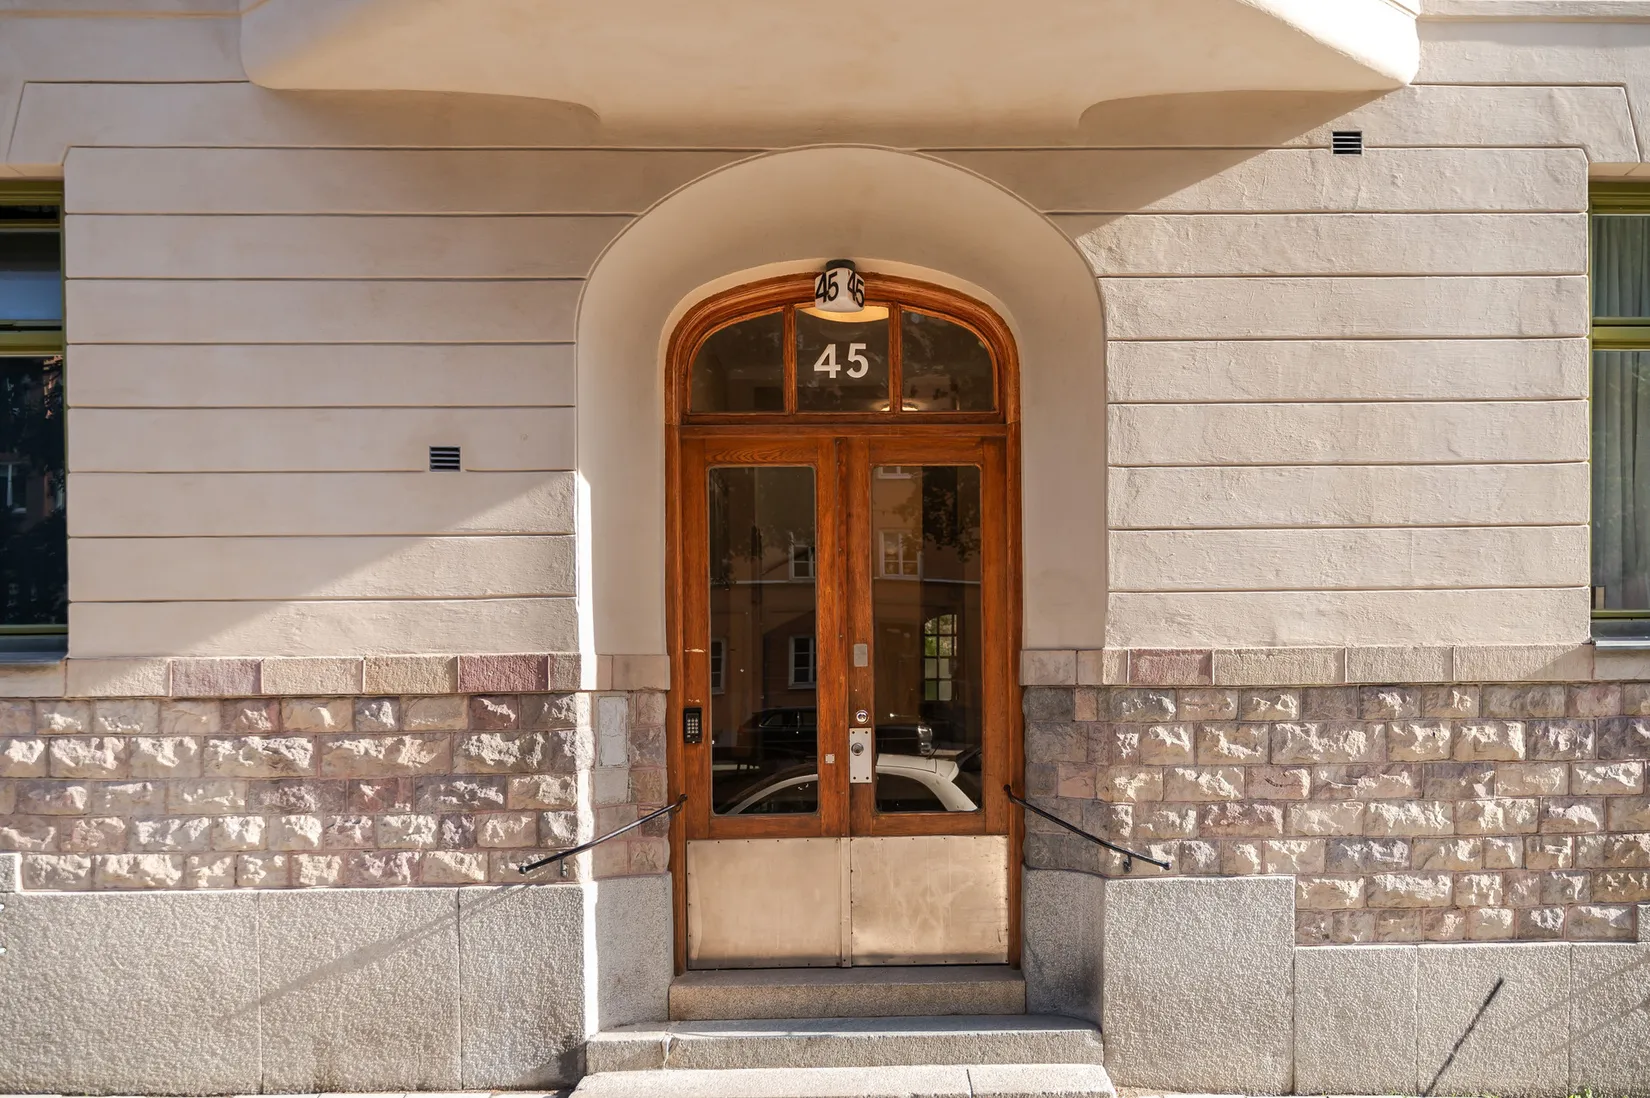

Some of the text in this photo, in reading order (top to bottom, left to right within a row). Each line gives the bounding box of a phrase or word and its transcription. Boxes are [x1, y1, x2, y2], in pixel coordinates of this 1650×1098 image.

[815, 271, 839, 303] 45
[847, 271, 864, 308] 45
[813, 343, 869, 379] 45
